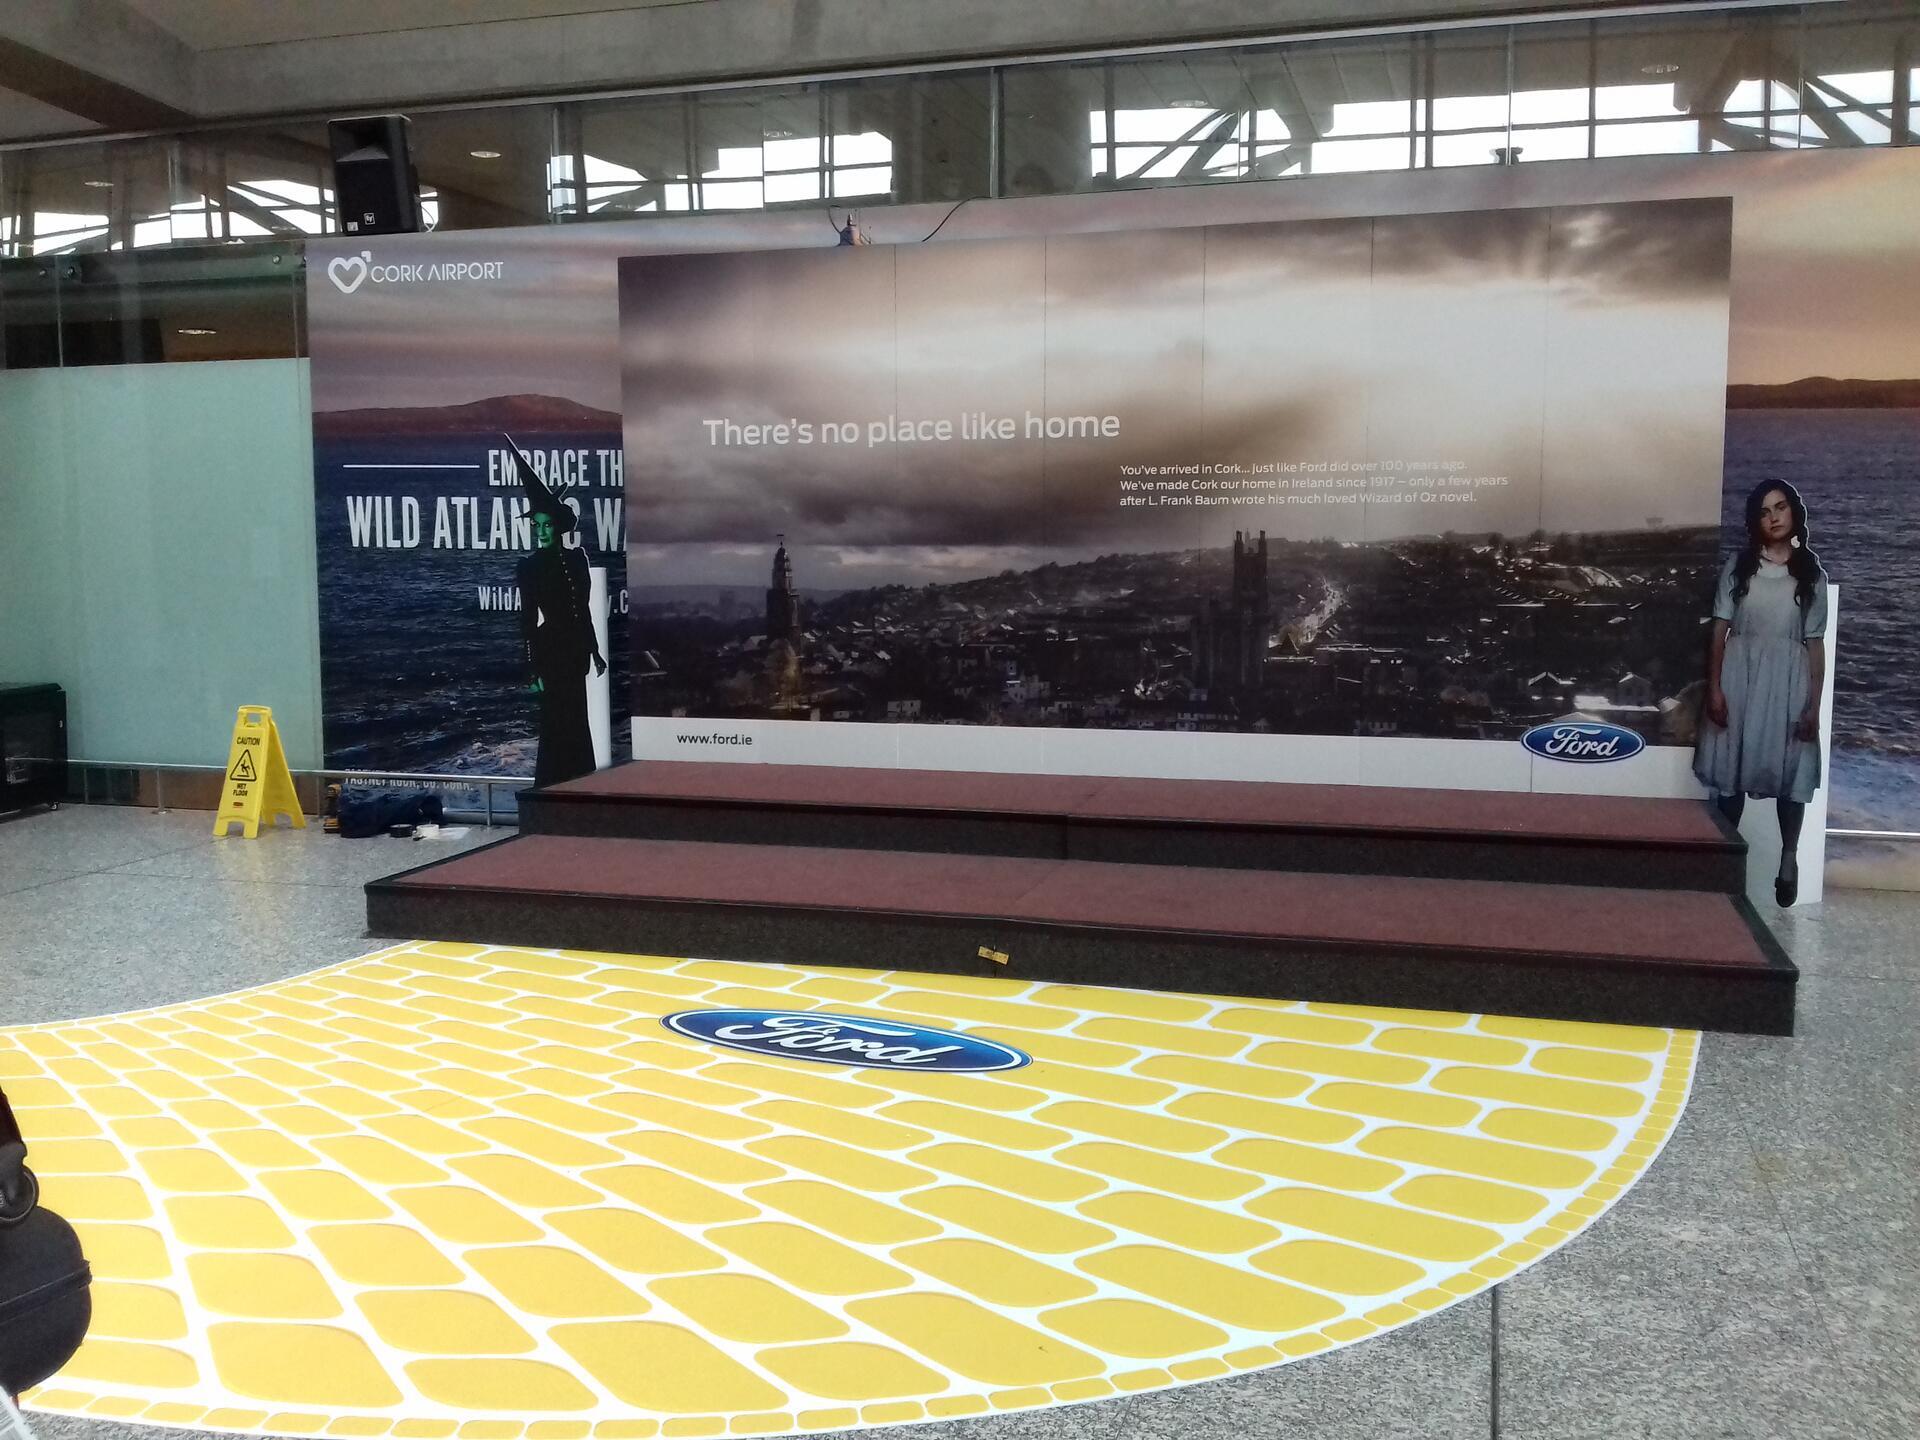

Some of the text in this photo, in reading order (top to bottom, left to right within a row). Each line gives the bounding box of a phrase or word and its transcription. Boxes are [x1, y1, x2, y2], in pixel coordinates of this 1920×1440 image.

[371, 262, 503, 283] CORK AIRPORT
[703, 411, 1121, 448] There's no place like home
[596, 449, 624, 486] TH
[1120, 465, 1158, 475] You've
[1159, 464, 1199, 475] arrived
[1201, 464, 1212, 474] in
[1276, 462, 1297, 473] like
[1299, 461, 1328, 473] Ford
[1329, 461, 1349, 472] did
[1351, 463, 1378, 472] over
[1406, 461, 1439, 472] years
[1441, 461, 1468, 472] ago.
[1120, 480, 1154, 491] We've
[1156, 479, 1189, 490] made
[1191, 479, 1218, 490] Cork
[1220, 480, 1239, 489] our
[1242, 478, 1276, 489] home
[1278, 478, 1289, 488] in
[1292, 476, 1333, 488] Ireland
[1336, 476, 1367, 487] since
[1409, 476, 1436, 488] only
[1437, 477, 1446, 486] a
[1448, 474, 1472, 486] few
[1474, 476, 1509, 488] years
[1119, 491, 1477, 506] after L. Frank Baum wrote his much loved Wizard of Oz novel.
[346, 495, 627, 552] WILD ATLANC W
[236, 736, 261, 746] CAUTION
[676, 733, 753, 746] www.ford.ie
[1545, 726, 1620, 756] Ford
[714, 1016, 965, 1064] Ford
